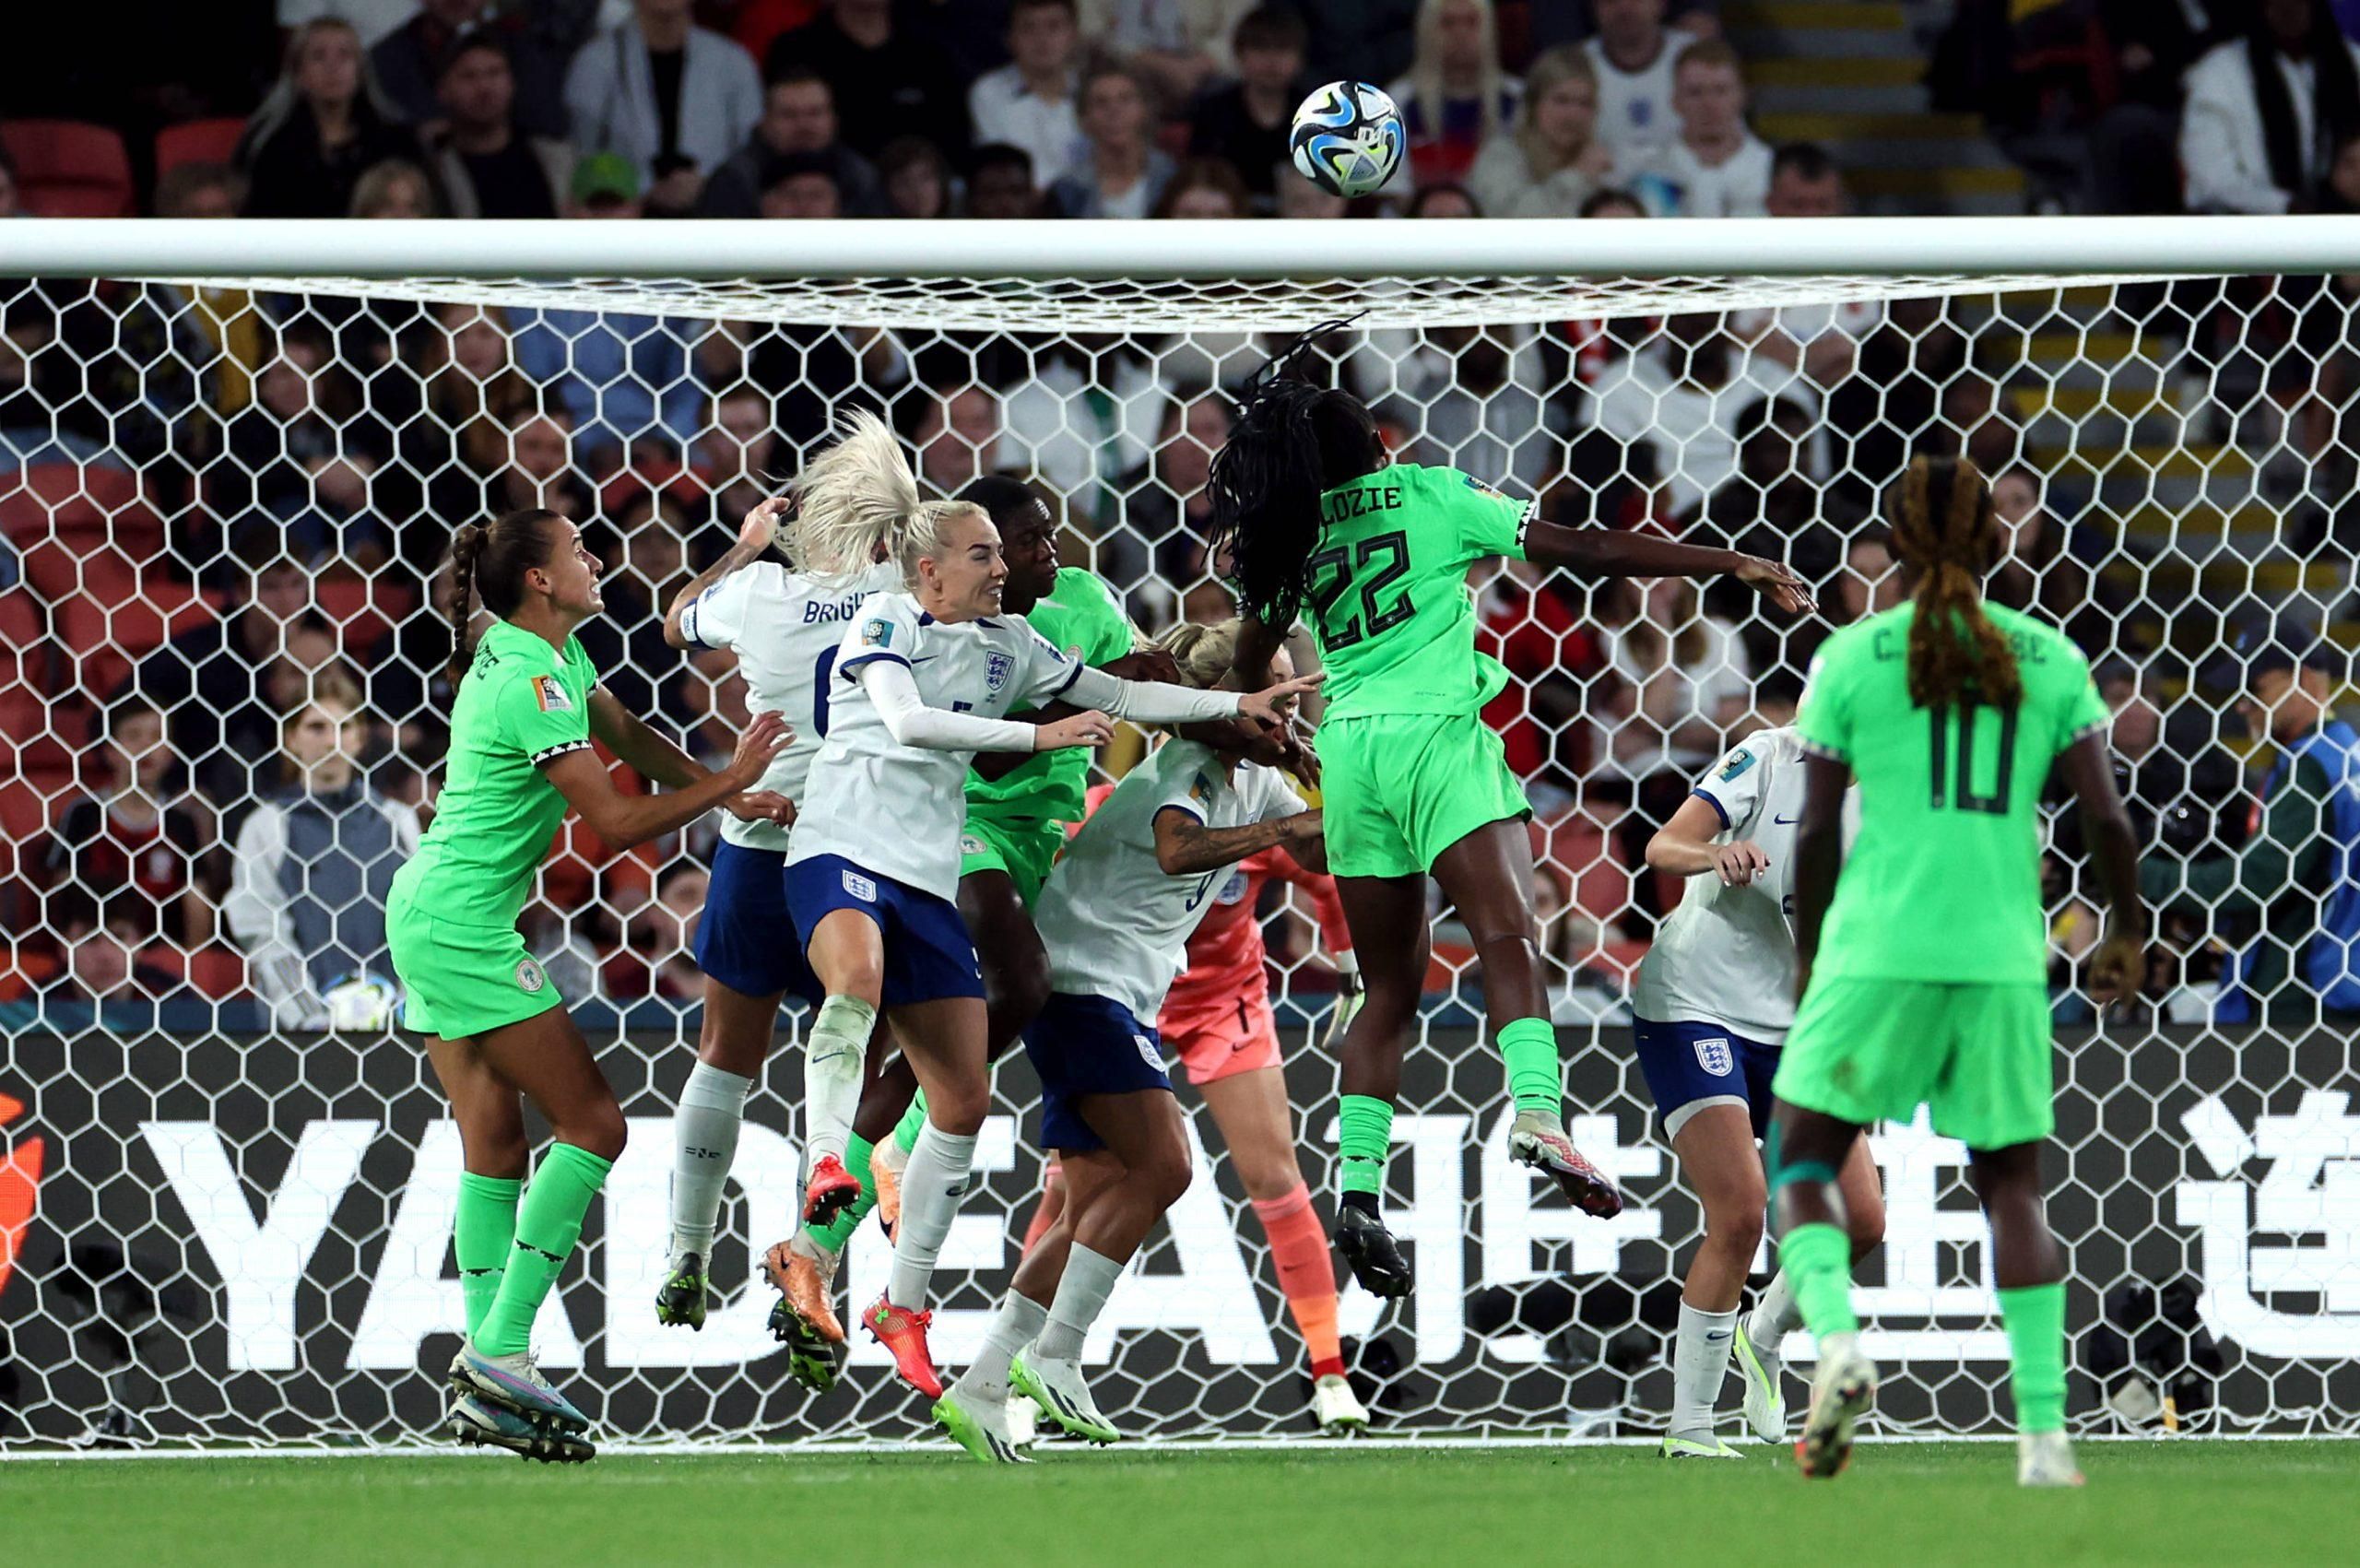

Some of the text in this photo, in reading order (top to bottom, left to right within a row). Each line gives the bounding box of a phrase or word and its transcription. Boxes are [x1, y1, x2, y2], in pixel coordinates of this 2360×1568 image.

[1303, 530, 1416, 654] 22
[1913, 687, 2020, 816] 10
[138, 1114, 1280, 1372] YADEA
